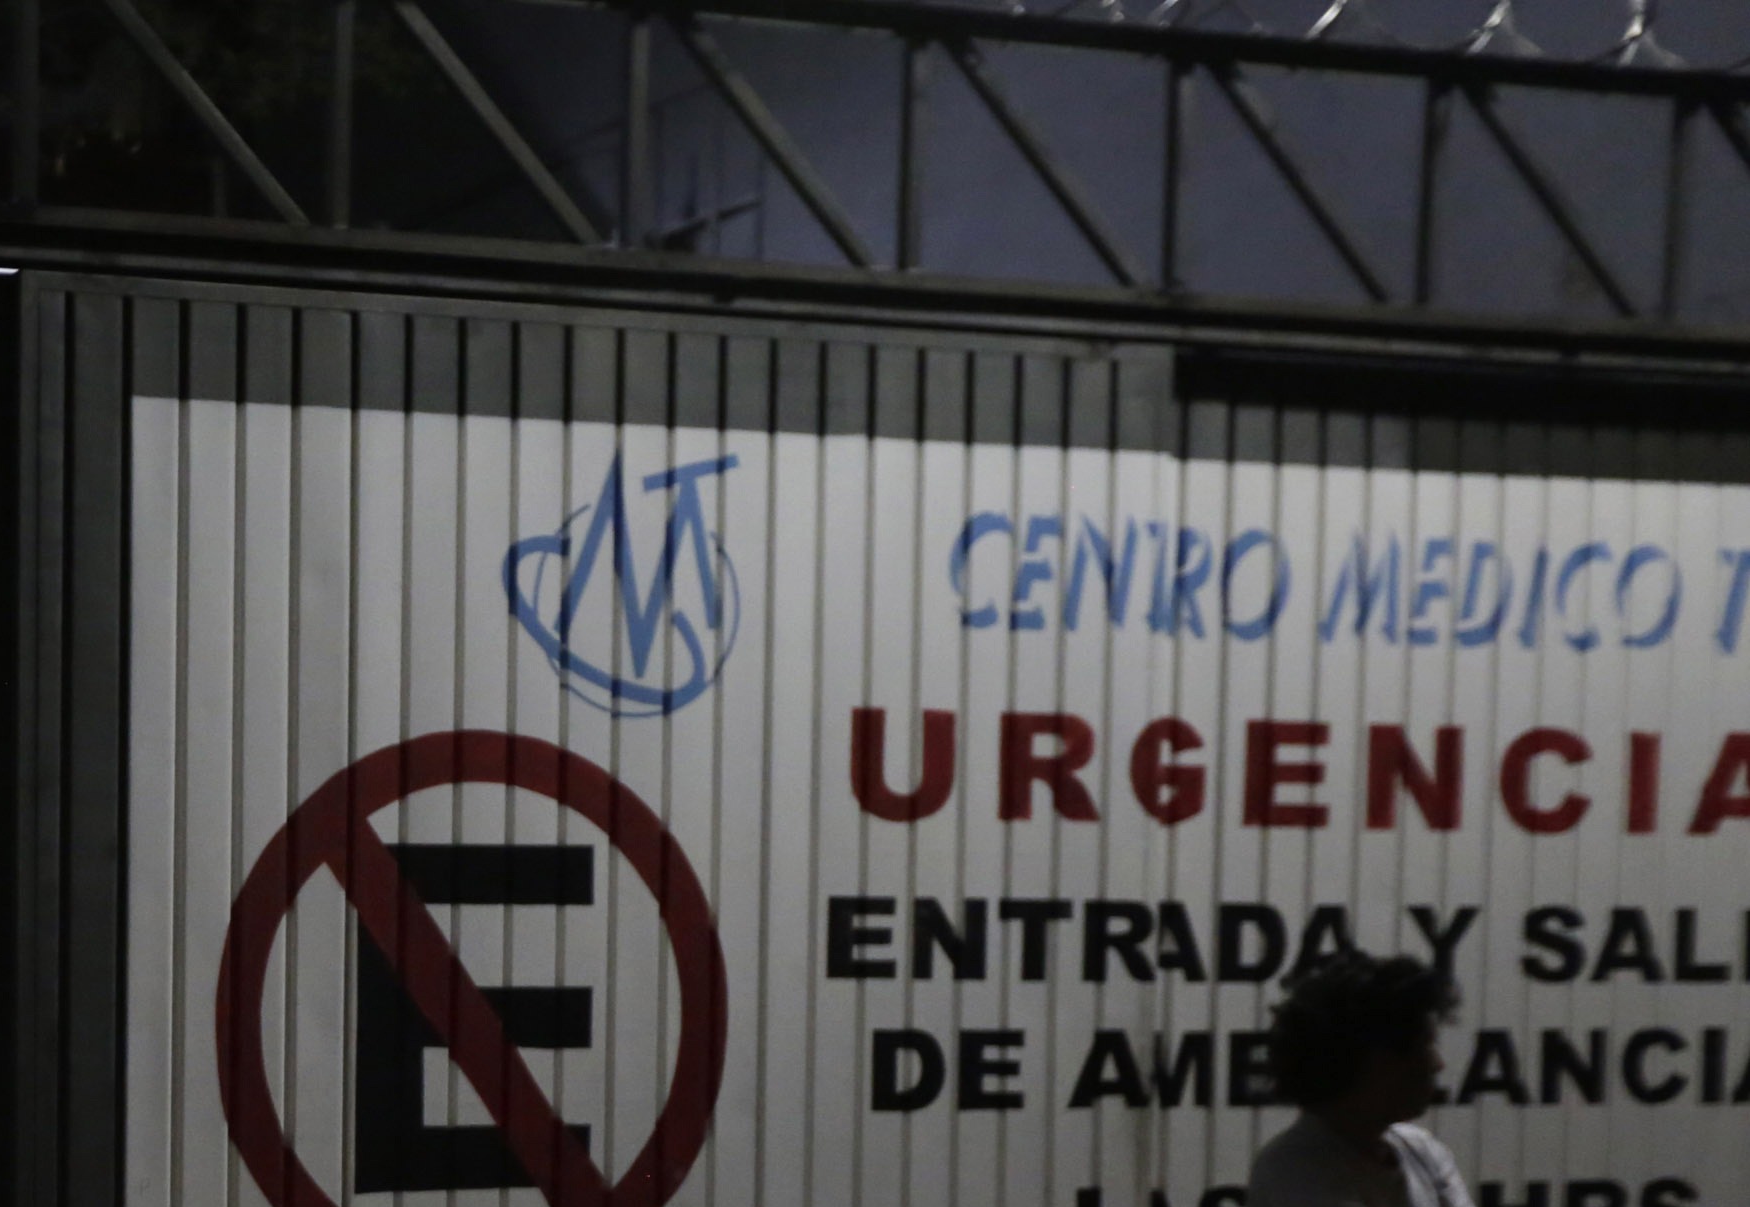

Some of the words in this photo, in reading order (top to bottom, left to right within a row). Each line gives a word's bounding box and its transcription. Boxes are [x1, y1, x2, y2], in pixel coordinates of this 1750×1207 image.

[948, 511, 1291, 642] CENTRO
[1319, 530, 1684, 651] MEDICO
[851, 707, 1750, 835] URGENCIA
[827, 896, 1354, 984] ENTRADA
[1408, 906, 1478, 980] Y
[1521, 905, 1750, 983] SAL
[872, 1030, 1025, 1111] DE
